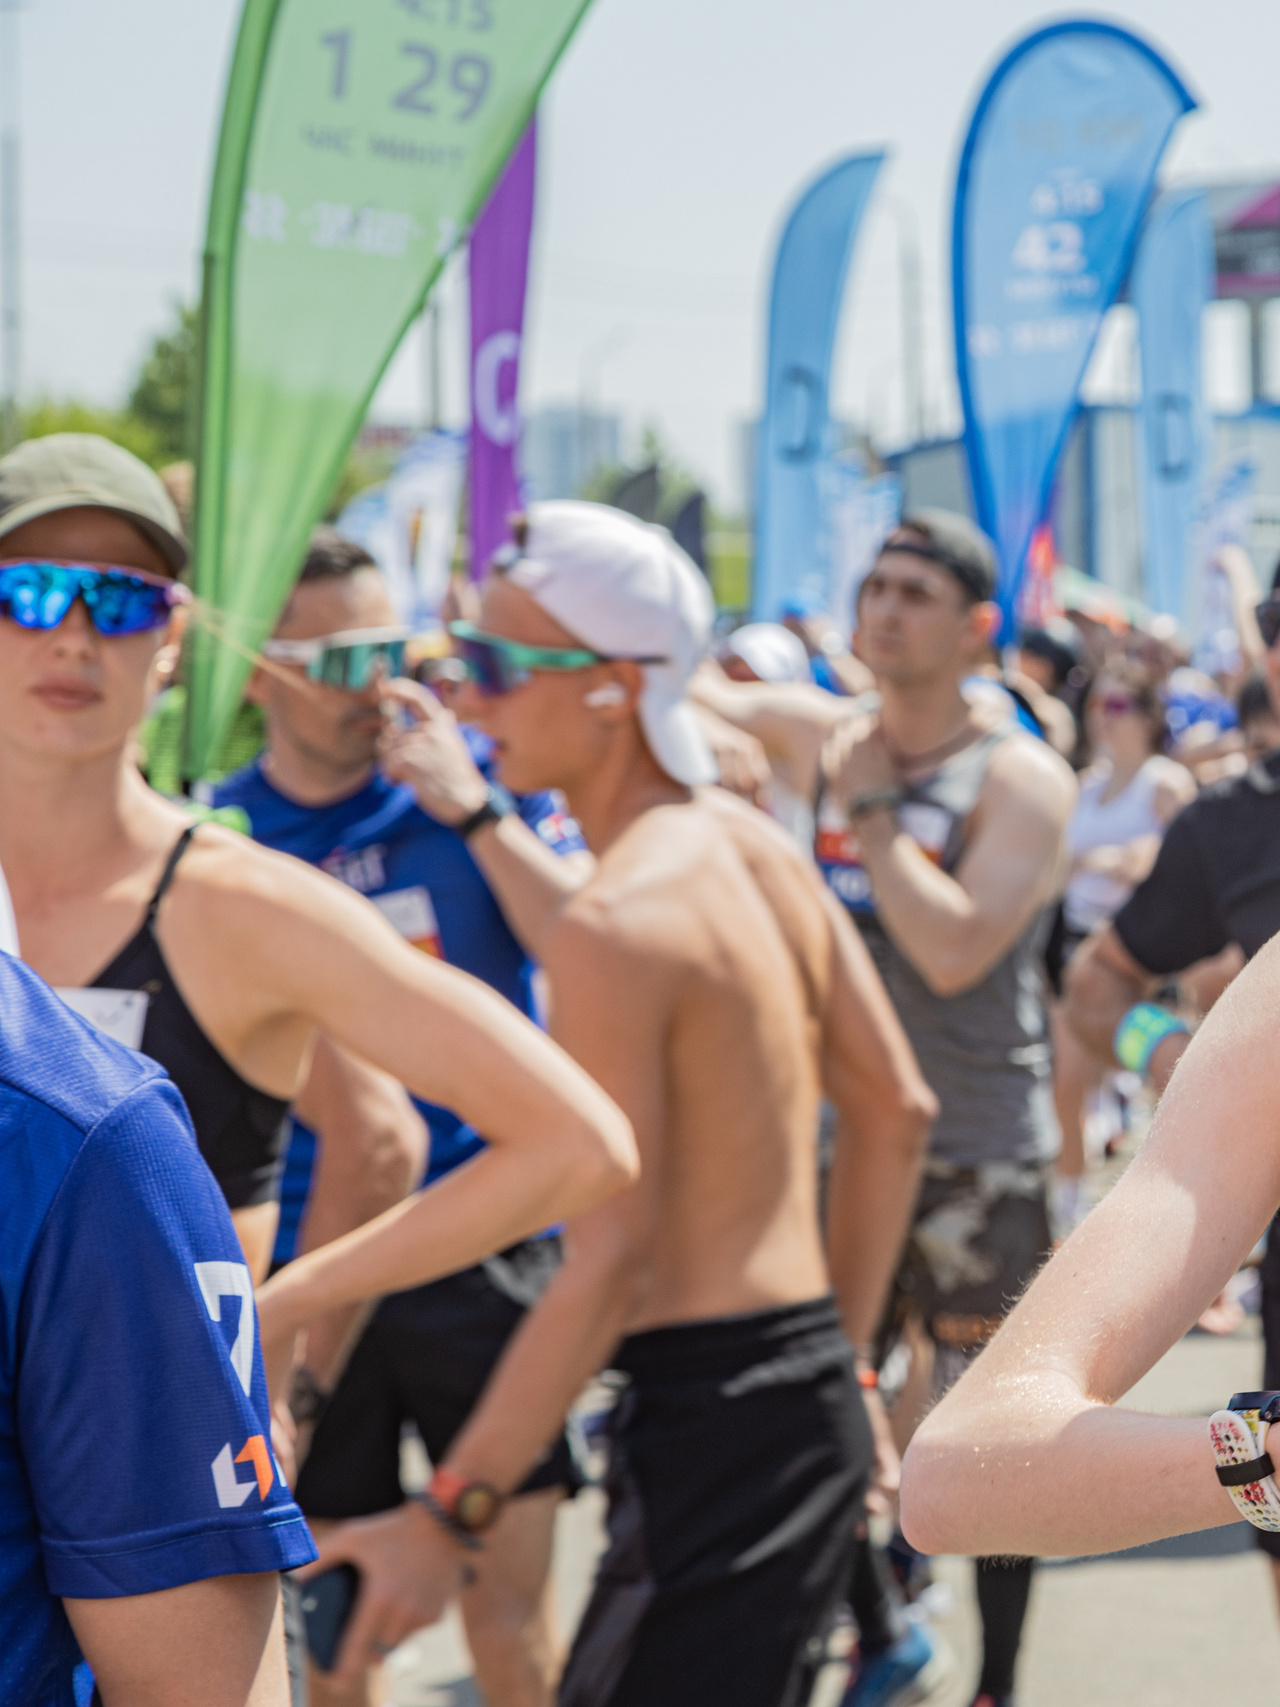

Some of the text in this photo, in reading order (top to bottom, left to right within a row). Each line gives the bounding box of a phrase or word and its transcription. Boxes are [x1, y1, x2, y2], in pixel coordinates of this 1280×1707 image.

[320, 25, 492, 122] 1 29
[1012, 220, 1087, 271] 42
[194, 1261, 254, 1397] 7
